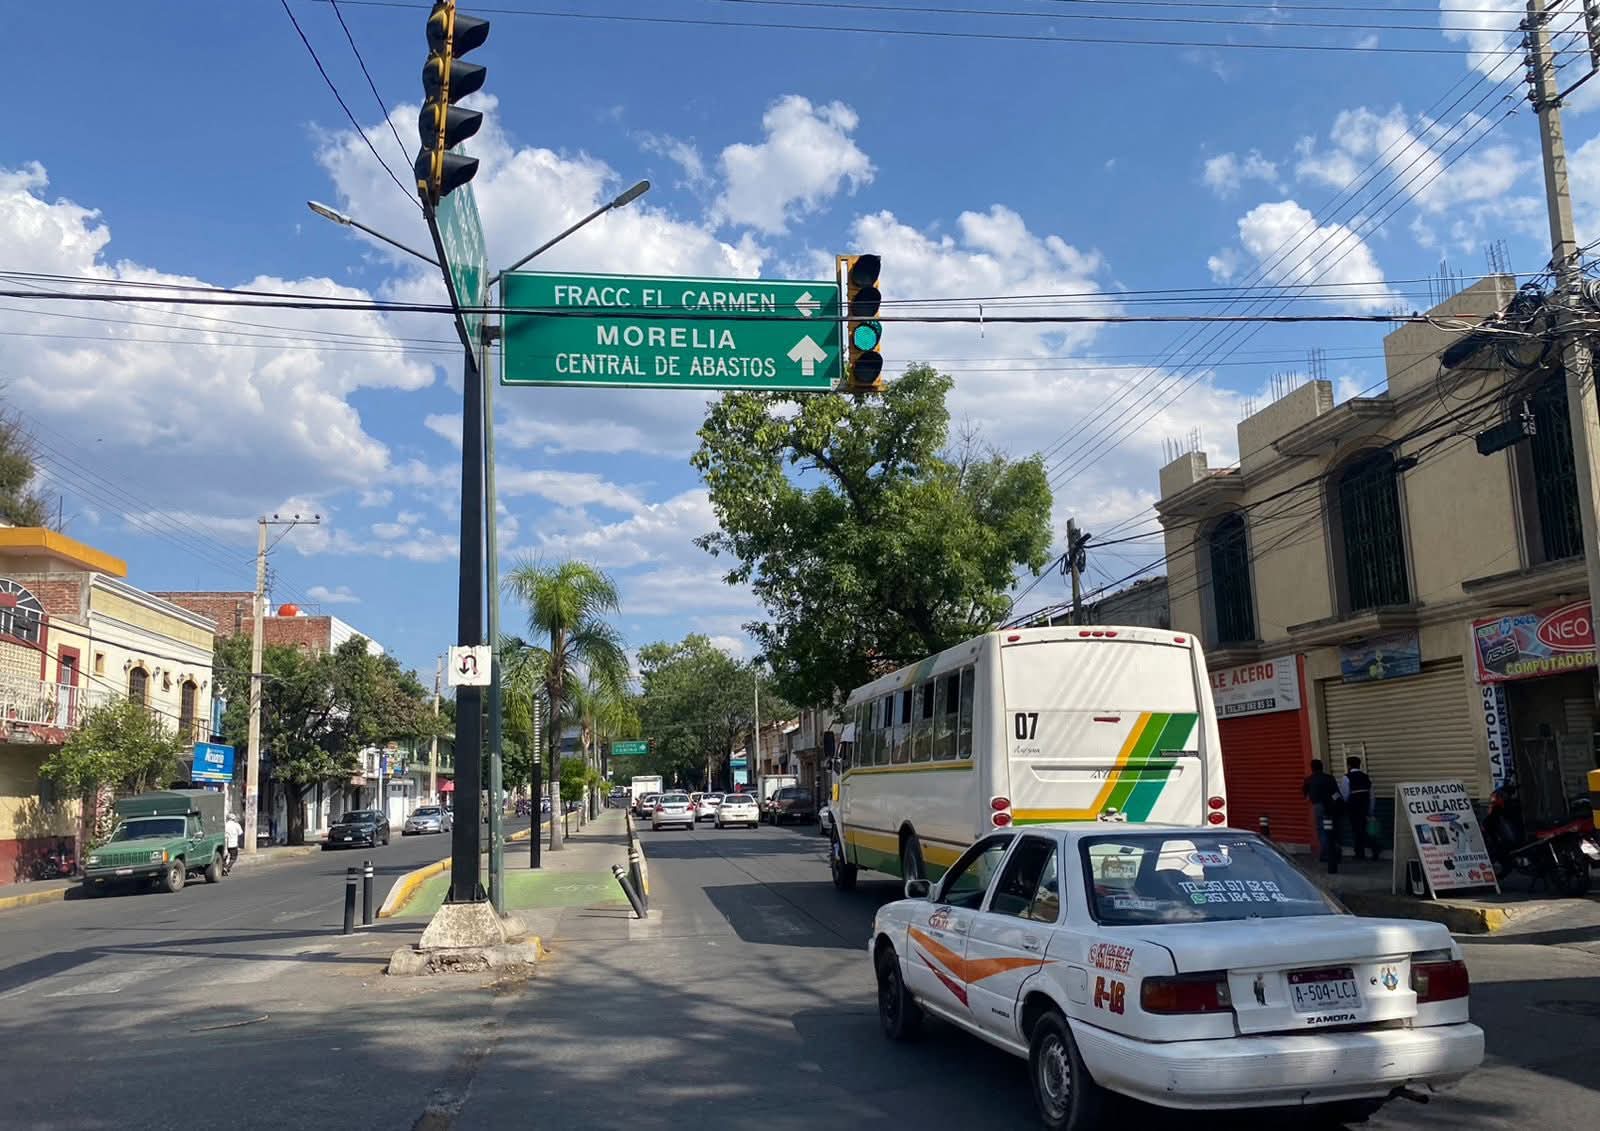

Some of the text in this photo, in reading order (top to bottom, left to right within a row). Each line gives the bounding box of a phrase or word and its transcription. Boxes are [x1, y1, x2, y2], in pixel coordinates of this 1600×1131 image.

[643, 288, 672, 309] EL
[682, 290, 776, 313] CARMEN
[596, 325, 736, 350] MORELIA
[555, 353, 776, 378] CENTRAL DE ABASTOS
[1548, 617, 1590, 642] NEO
[1486, 640, 1517, 664] ASUS
[1506, 652, 1596, 674] COMPUTADOR
[1231, 663, 1274, 686] ACERO
[1015, 713, 1039, 740] 07
[1482, 686, 1503, 778] LAPTOPS
[1403, 784, 1465, 797] REPARACION
[1408, 798, 1470, 815] CELULARES
[1093, 975, 1126, 1015] R-18
[1306, 1013, 1357, 1025] ZAMORA
